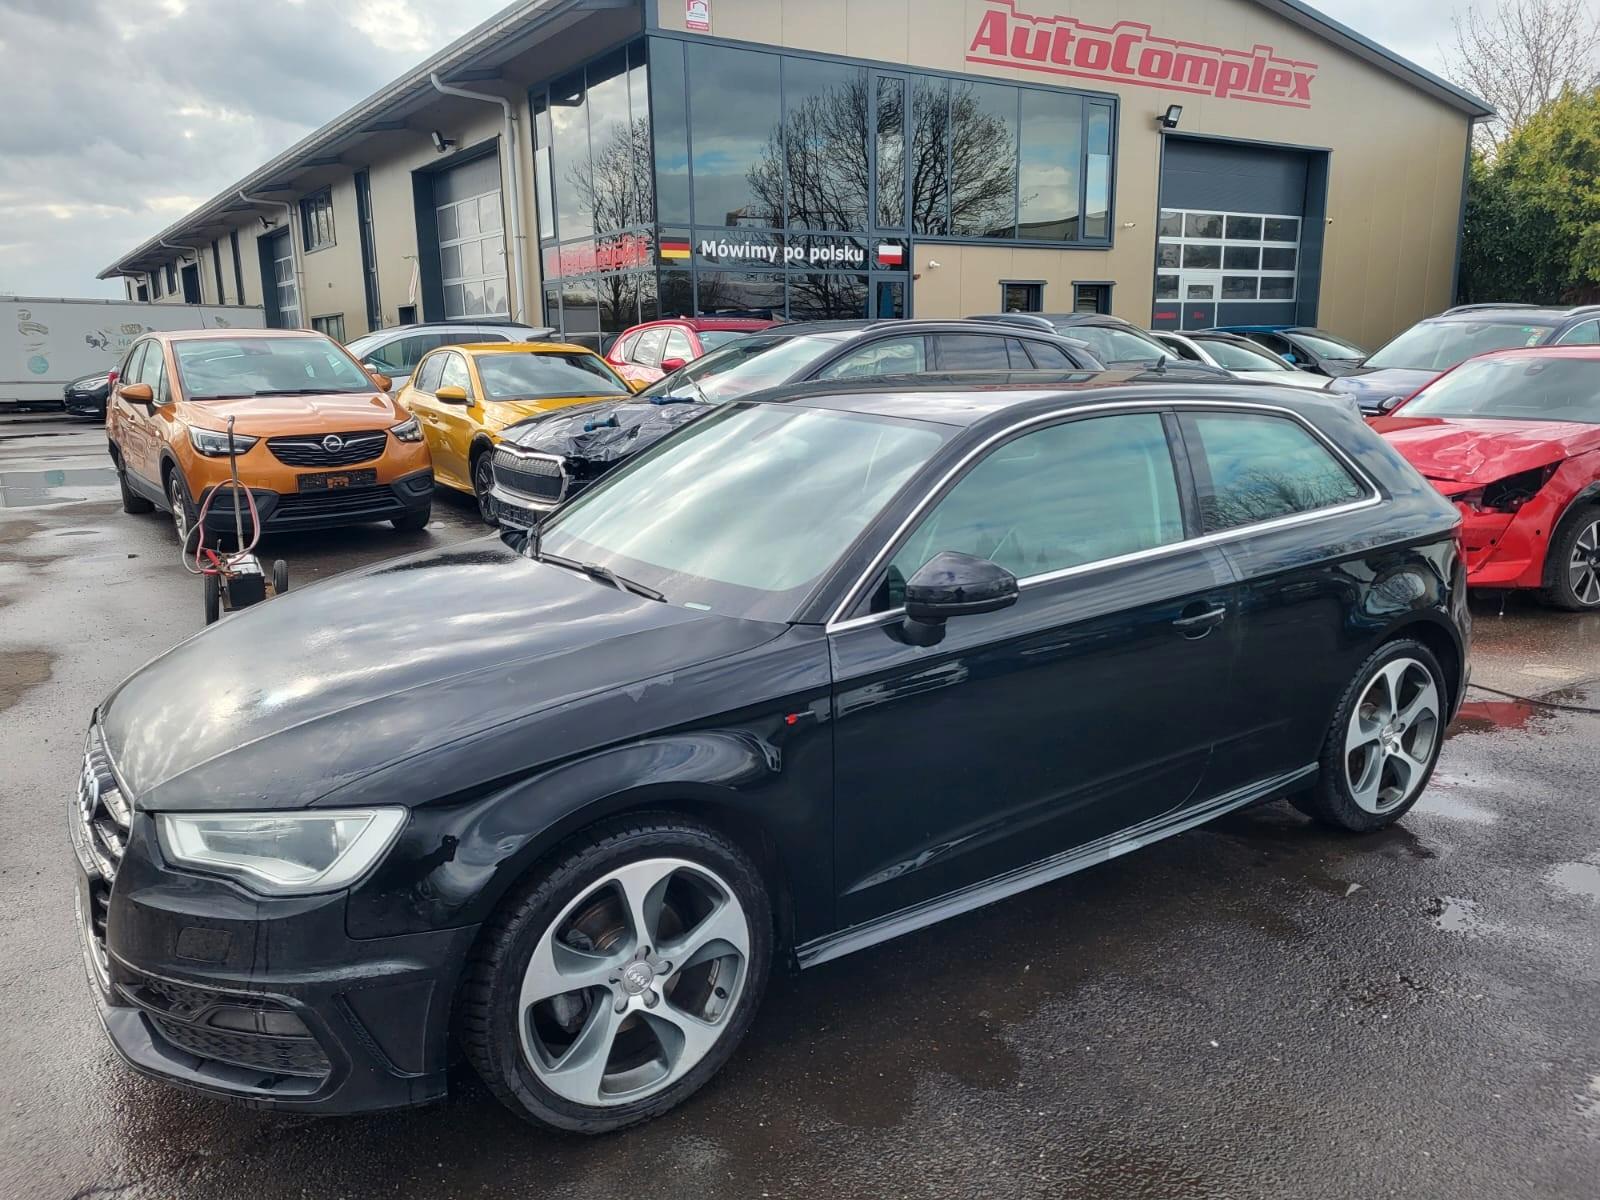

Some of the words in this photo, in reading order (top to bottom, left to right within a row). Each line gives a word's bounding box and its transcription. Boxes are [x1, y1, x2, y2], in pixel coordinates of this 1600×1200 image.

[970, 9, 1316, 100] AutoComplex
[701, 239, 778, 263] Mówimy
[783, 247, 804, 263] po
[809, 244, 864, 264] polsku
